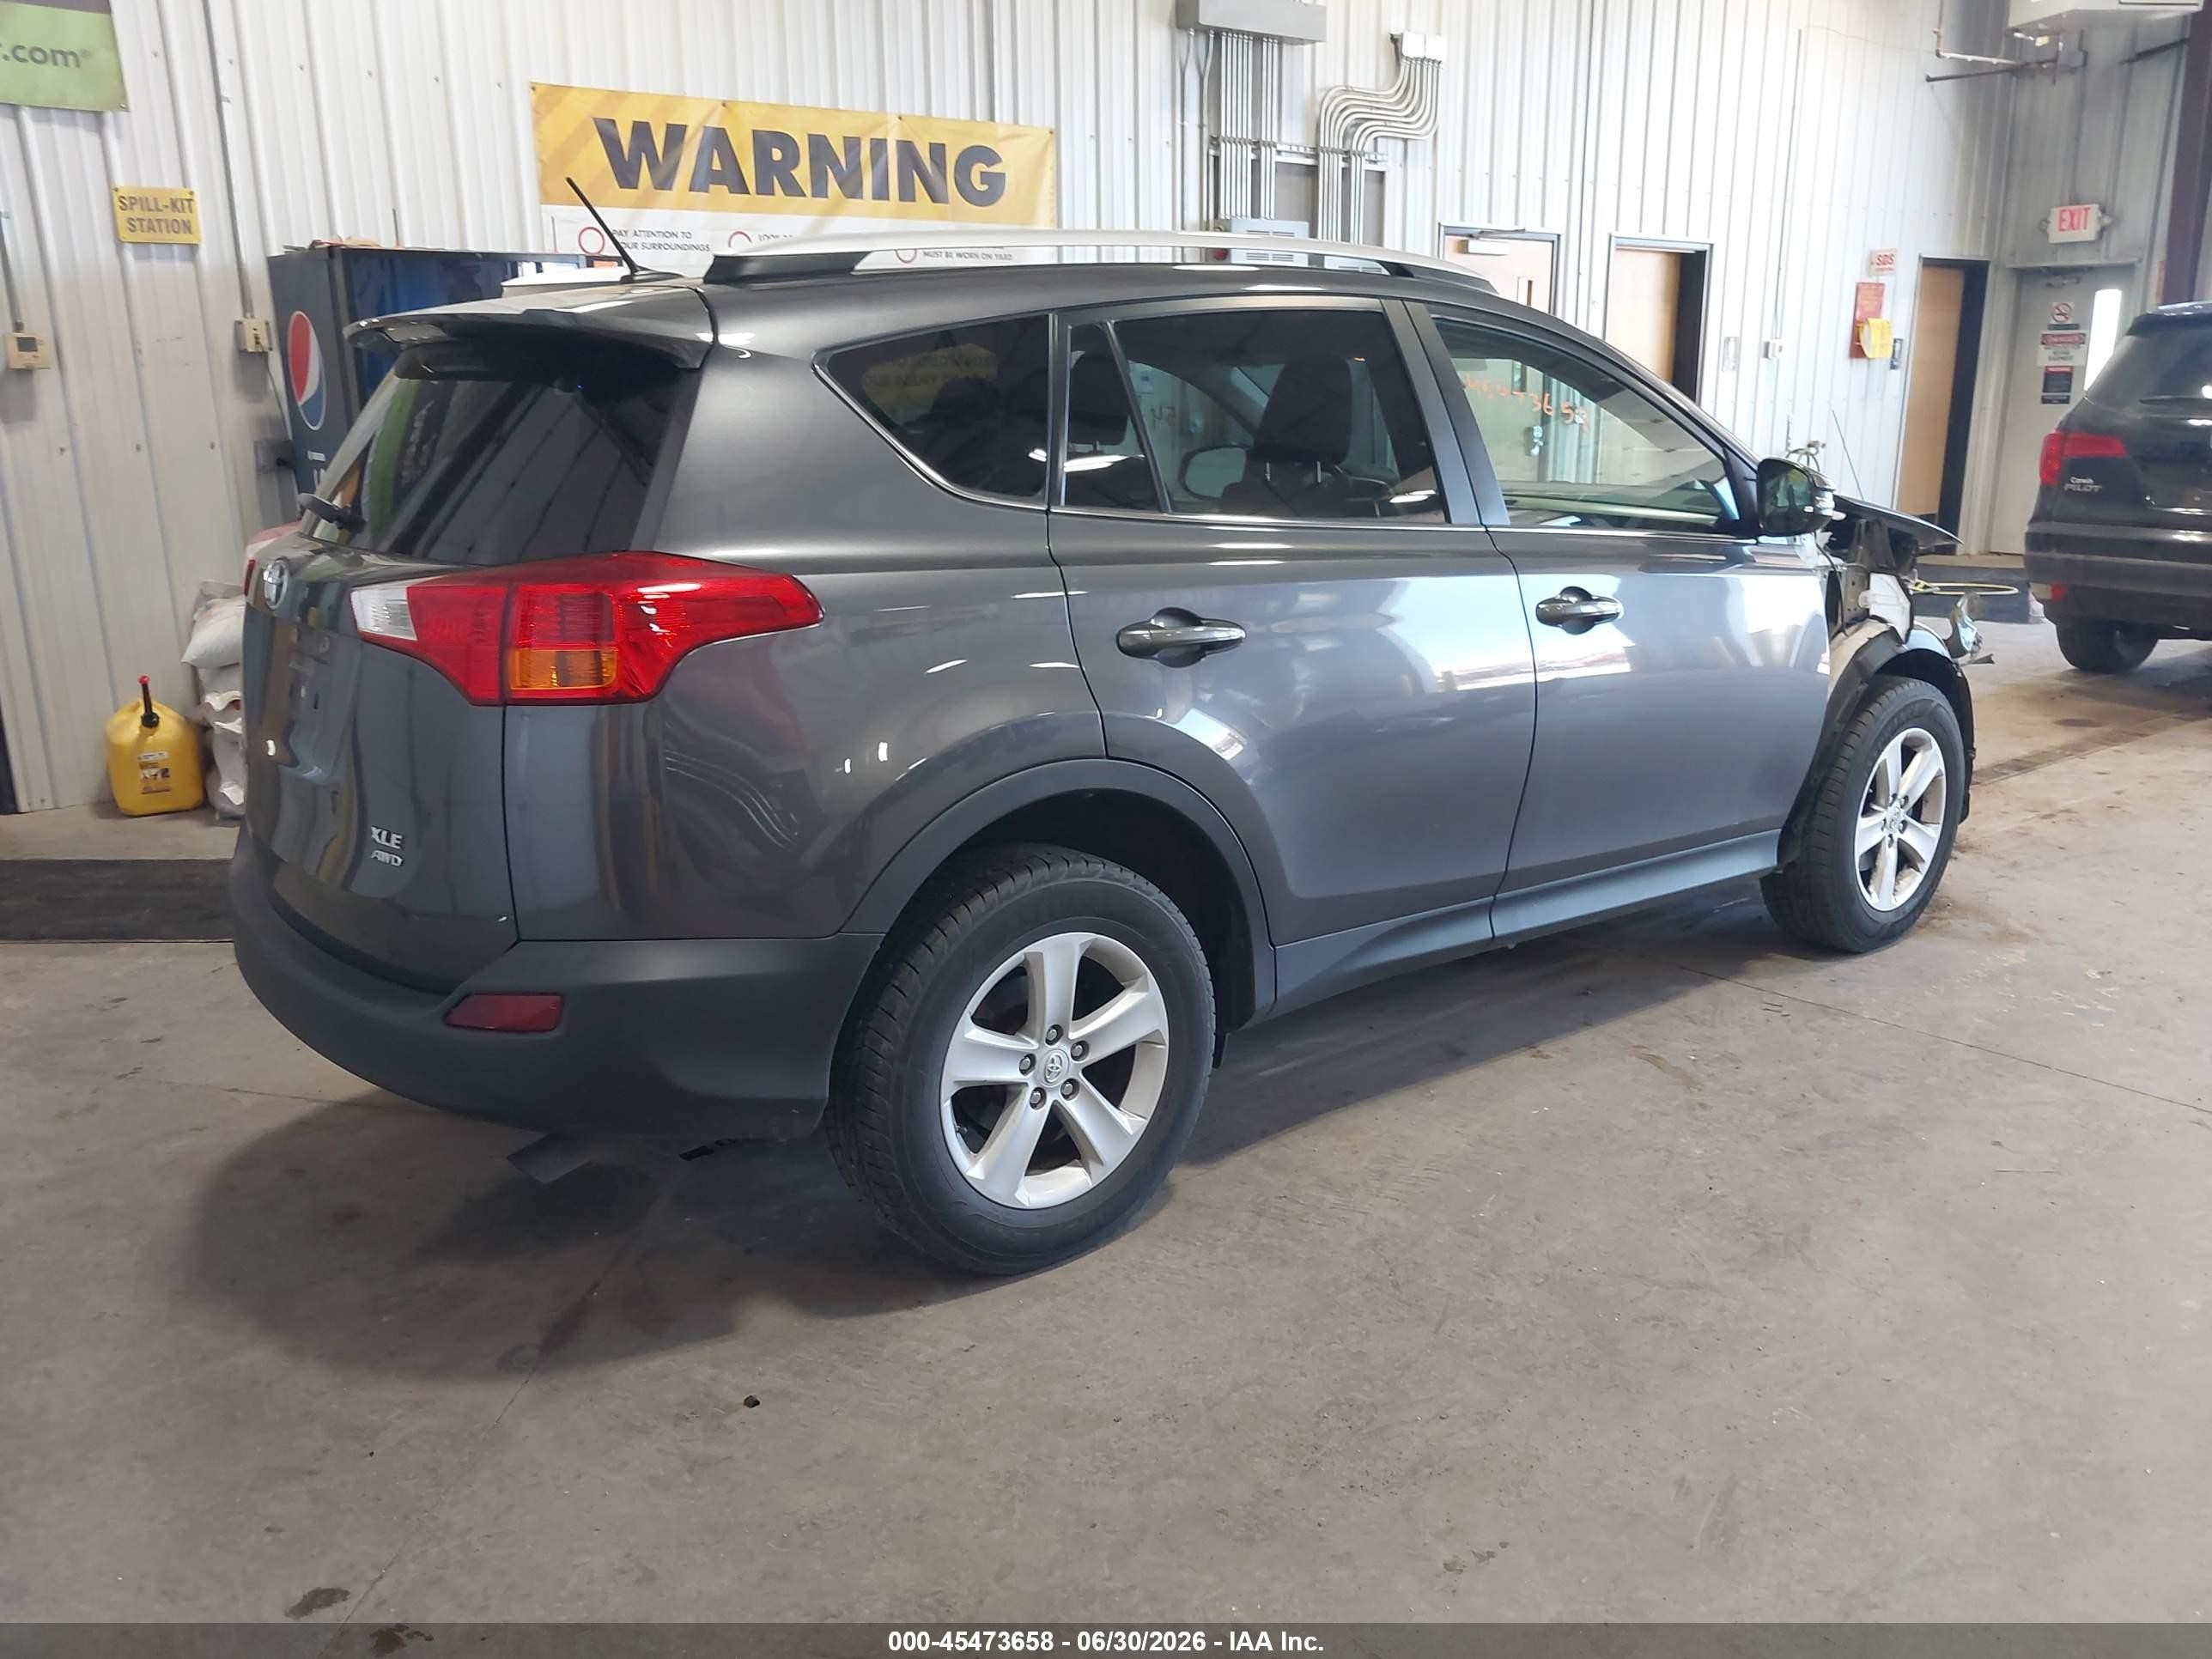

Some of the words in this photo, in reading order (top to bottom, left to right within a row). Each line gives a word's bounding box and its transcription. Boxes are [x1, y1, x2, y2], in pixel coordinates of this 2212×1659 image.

[0, 43, 81, 69] .com
[592, 116, 1006, 208] WARNING
[118, 195, 194, 214] SPILL-KIT
[126, 217, 193, 234] STATION
[2057, 207, 2091, 233] EXIT
[633, 229, 678, 240] ATTENTION
[680, 230, 692, 240] TO
[620, 241, 639, 250] OUR
[641, 241, 711, 252] SURROUNDINGS
[1875, 253, 1894, 266] SDS
[2063, 483, 2102, 493] PILOT
[370, 825, 403, 849] XLE
[370, 849, 403, 866] AWD
